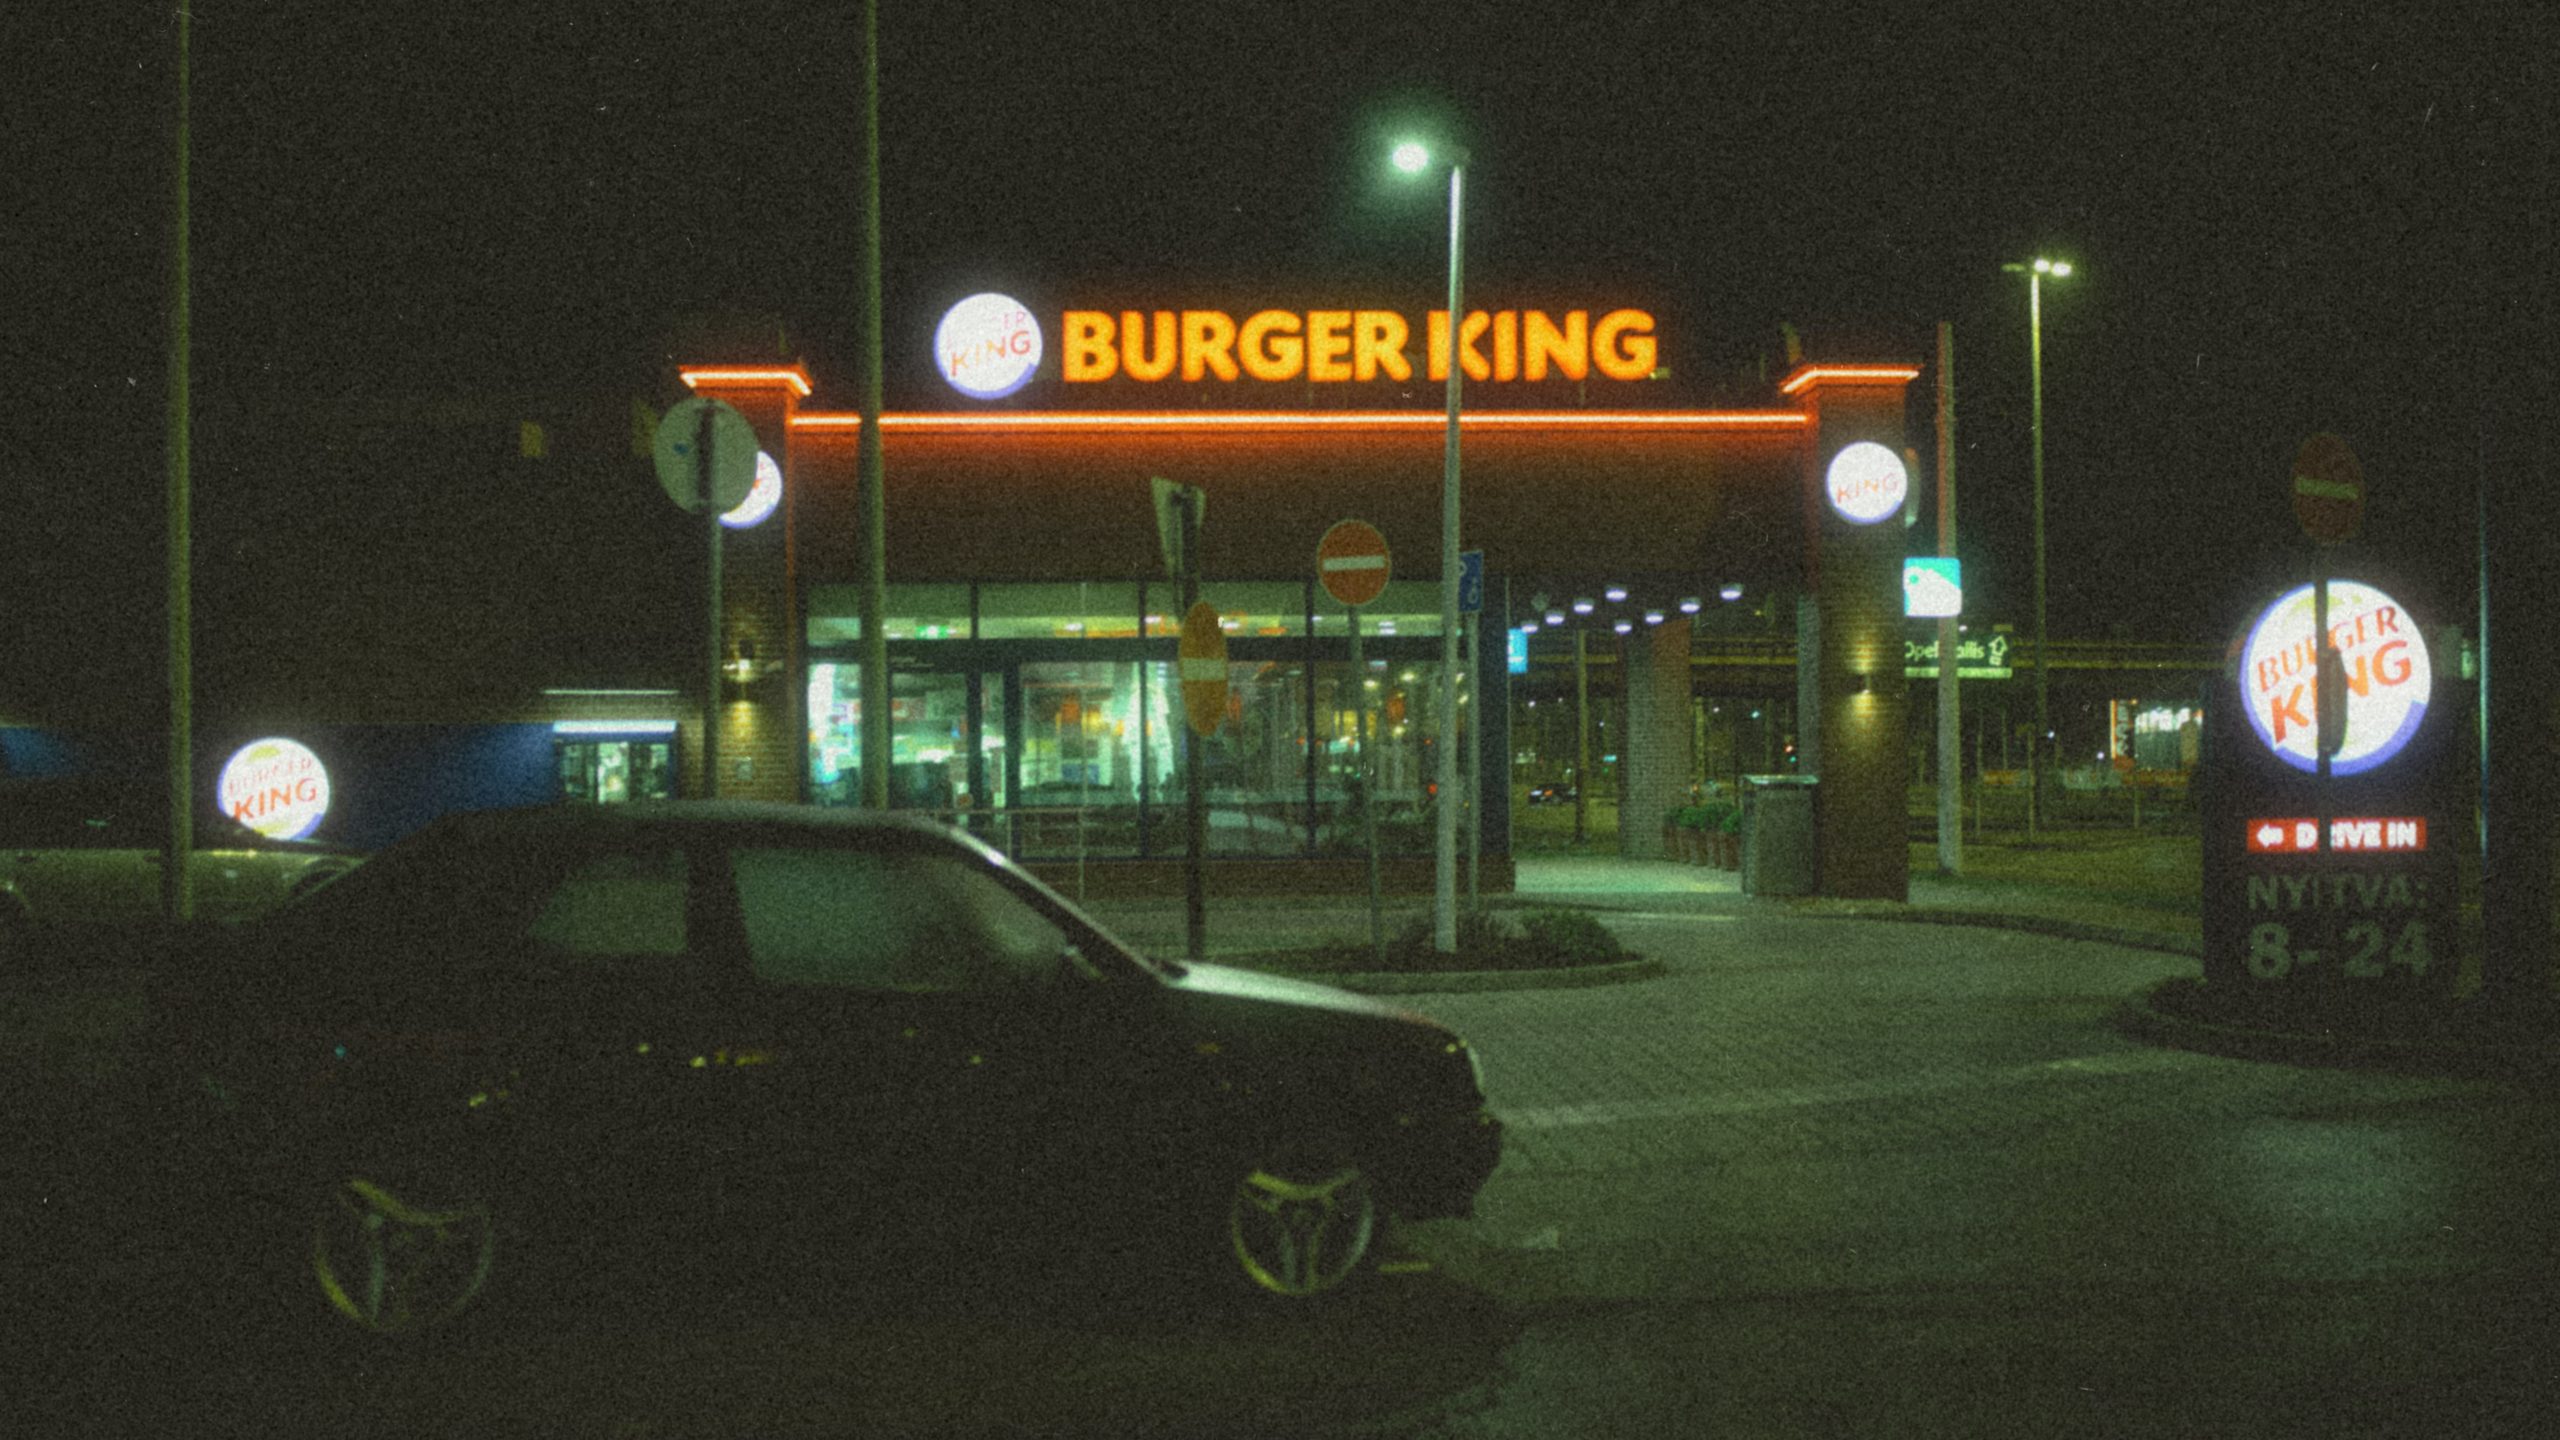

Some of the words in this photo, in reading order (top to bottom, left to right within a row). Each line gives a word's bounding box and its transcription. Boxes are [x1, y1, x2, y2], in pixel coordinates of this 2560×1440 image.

[951, 330, 1031, 377] KING
[1063, 310, 1411, 382] BURGER
[1427, 309, 1657, 382] KING
[233, 777, 317, 821] KING
[2387, 821, 2417, 848] IN
